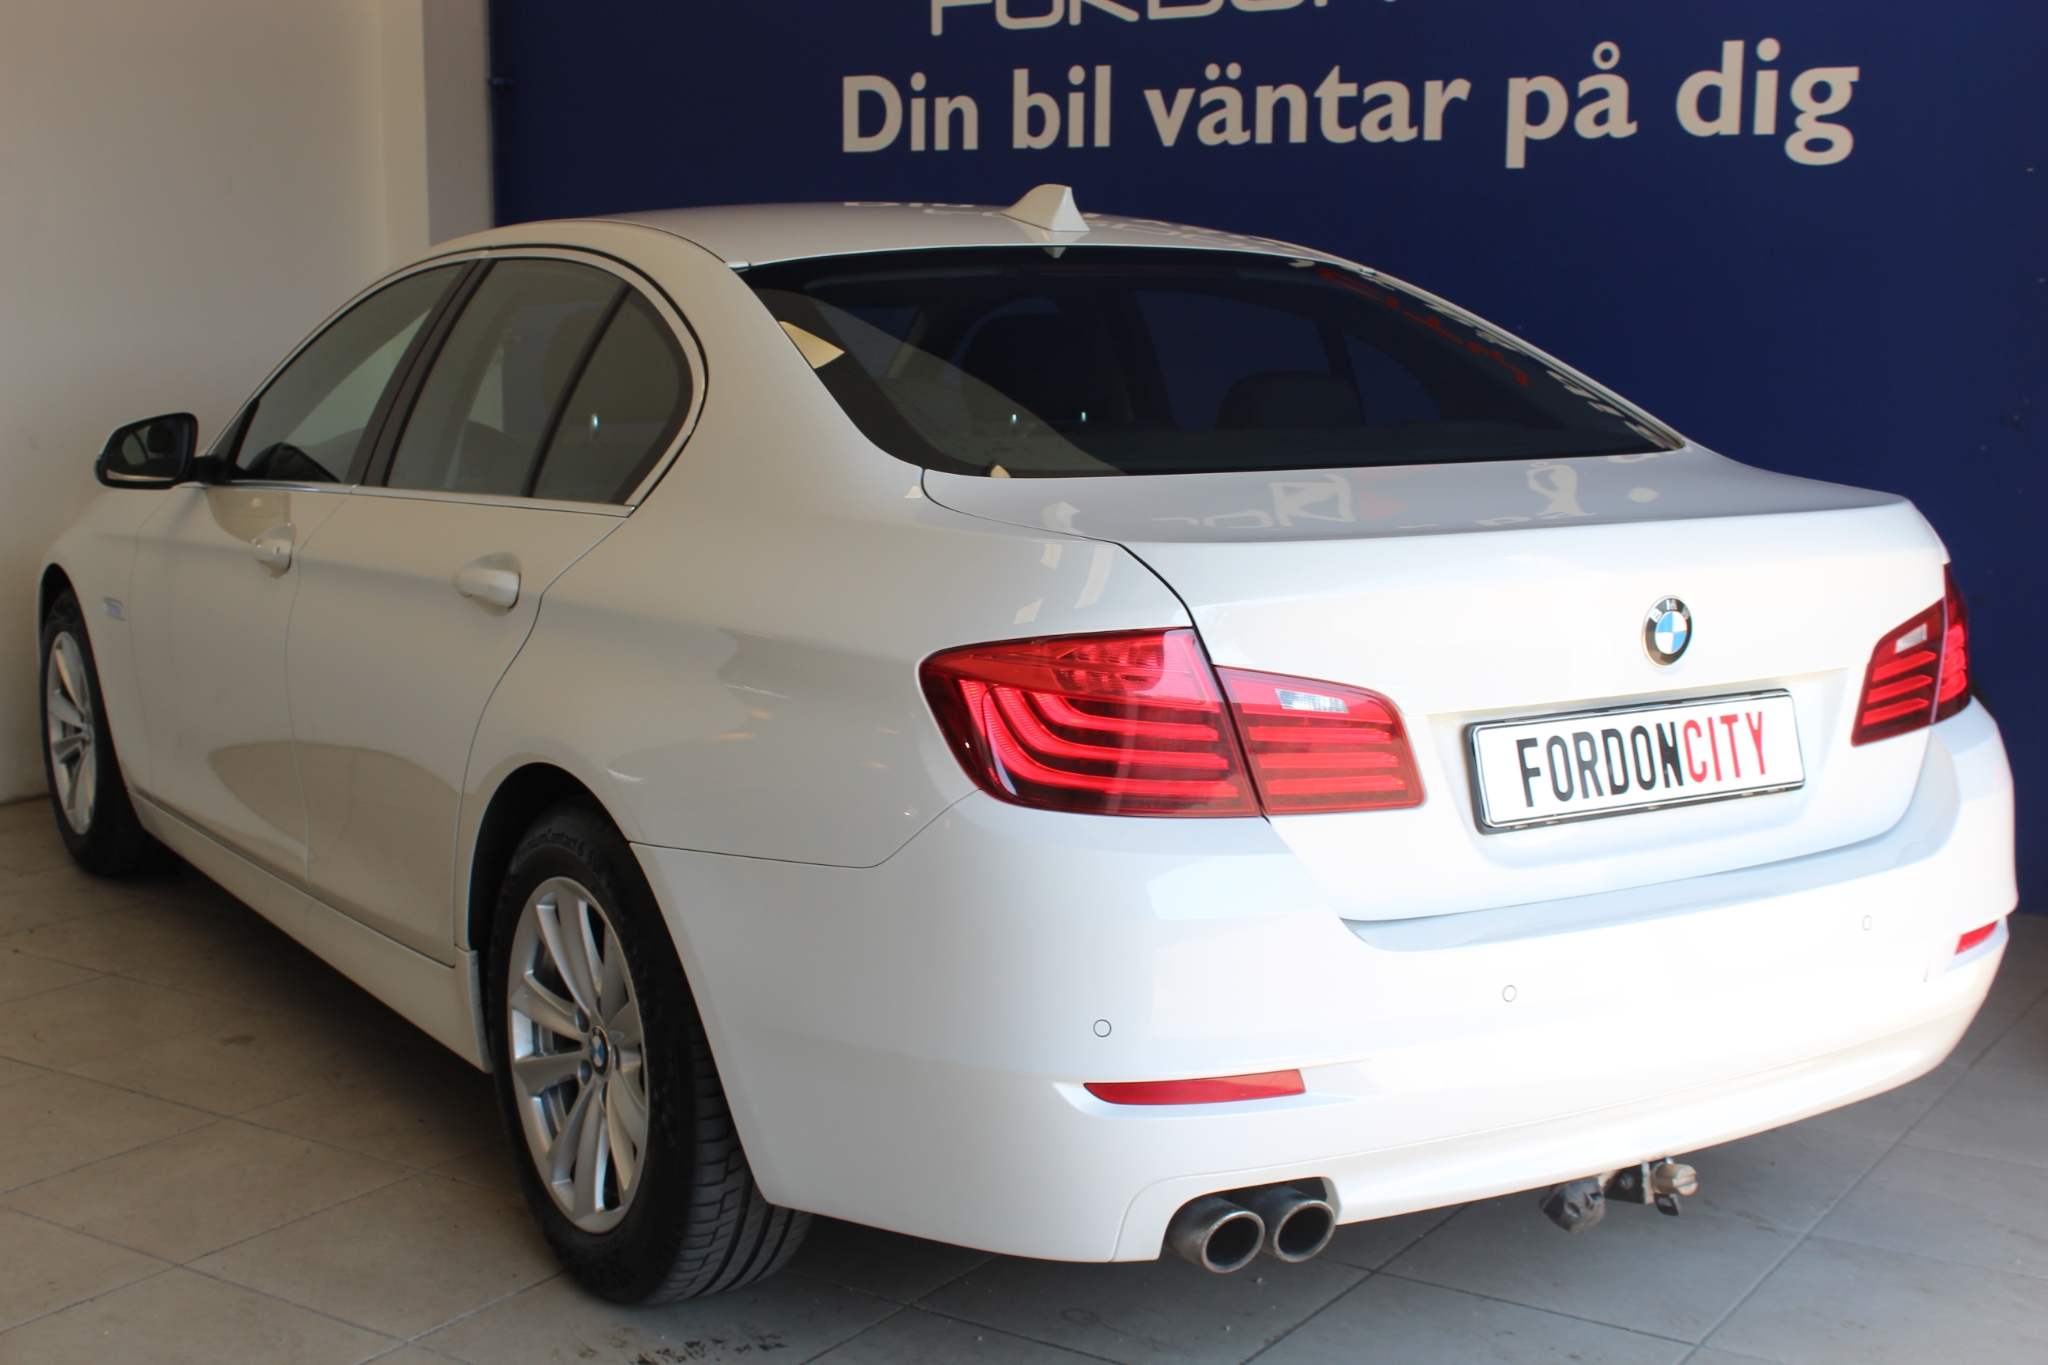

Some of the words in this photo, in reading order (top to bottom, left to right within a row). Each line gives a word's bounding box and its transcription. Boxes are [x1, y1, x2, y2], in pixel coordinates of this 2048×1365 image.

[843, 73, 978, 153] Din
[1013, 65, 1111, 150] bil
[1144, 62, 1471, 146] väntar
[1506, 42, 1637, 168] på
[1676, 38, 1860, 166] dig
[1516, 711, 1766, 807] FORDONCITY
